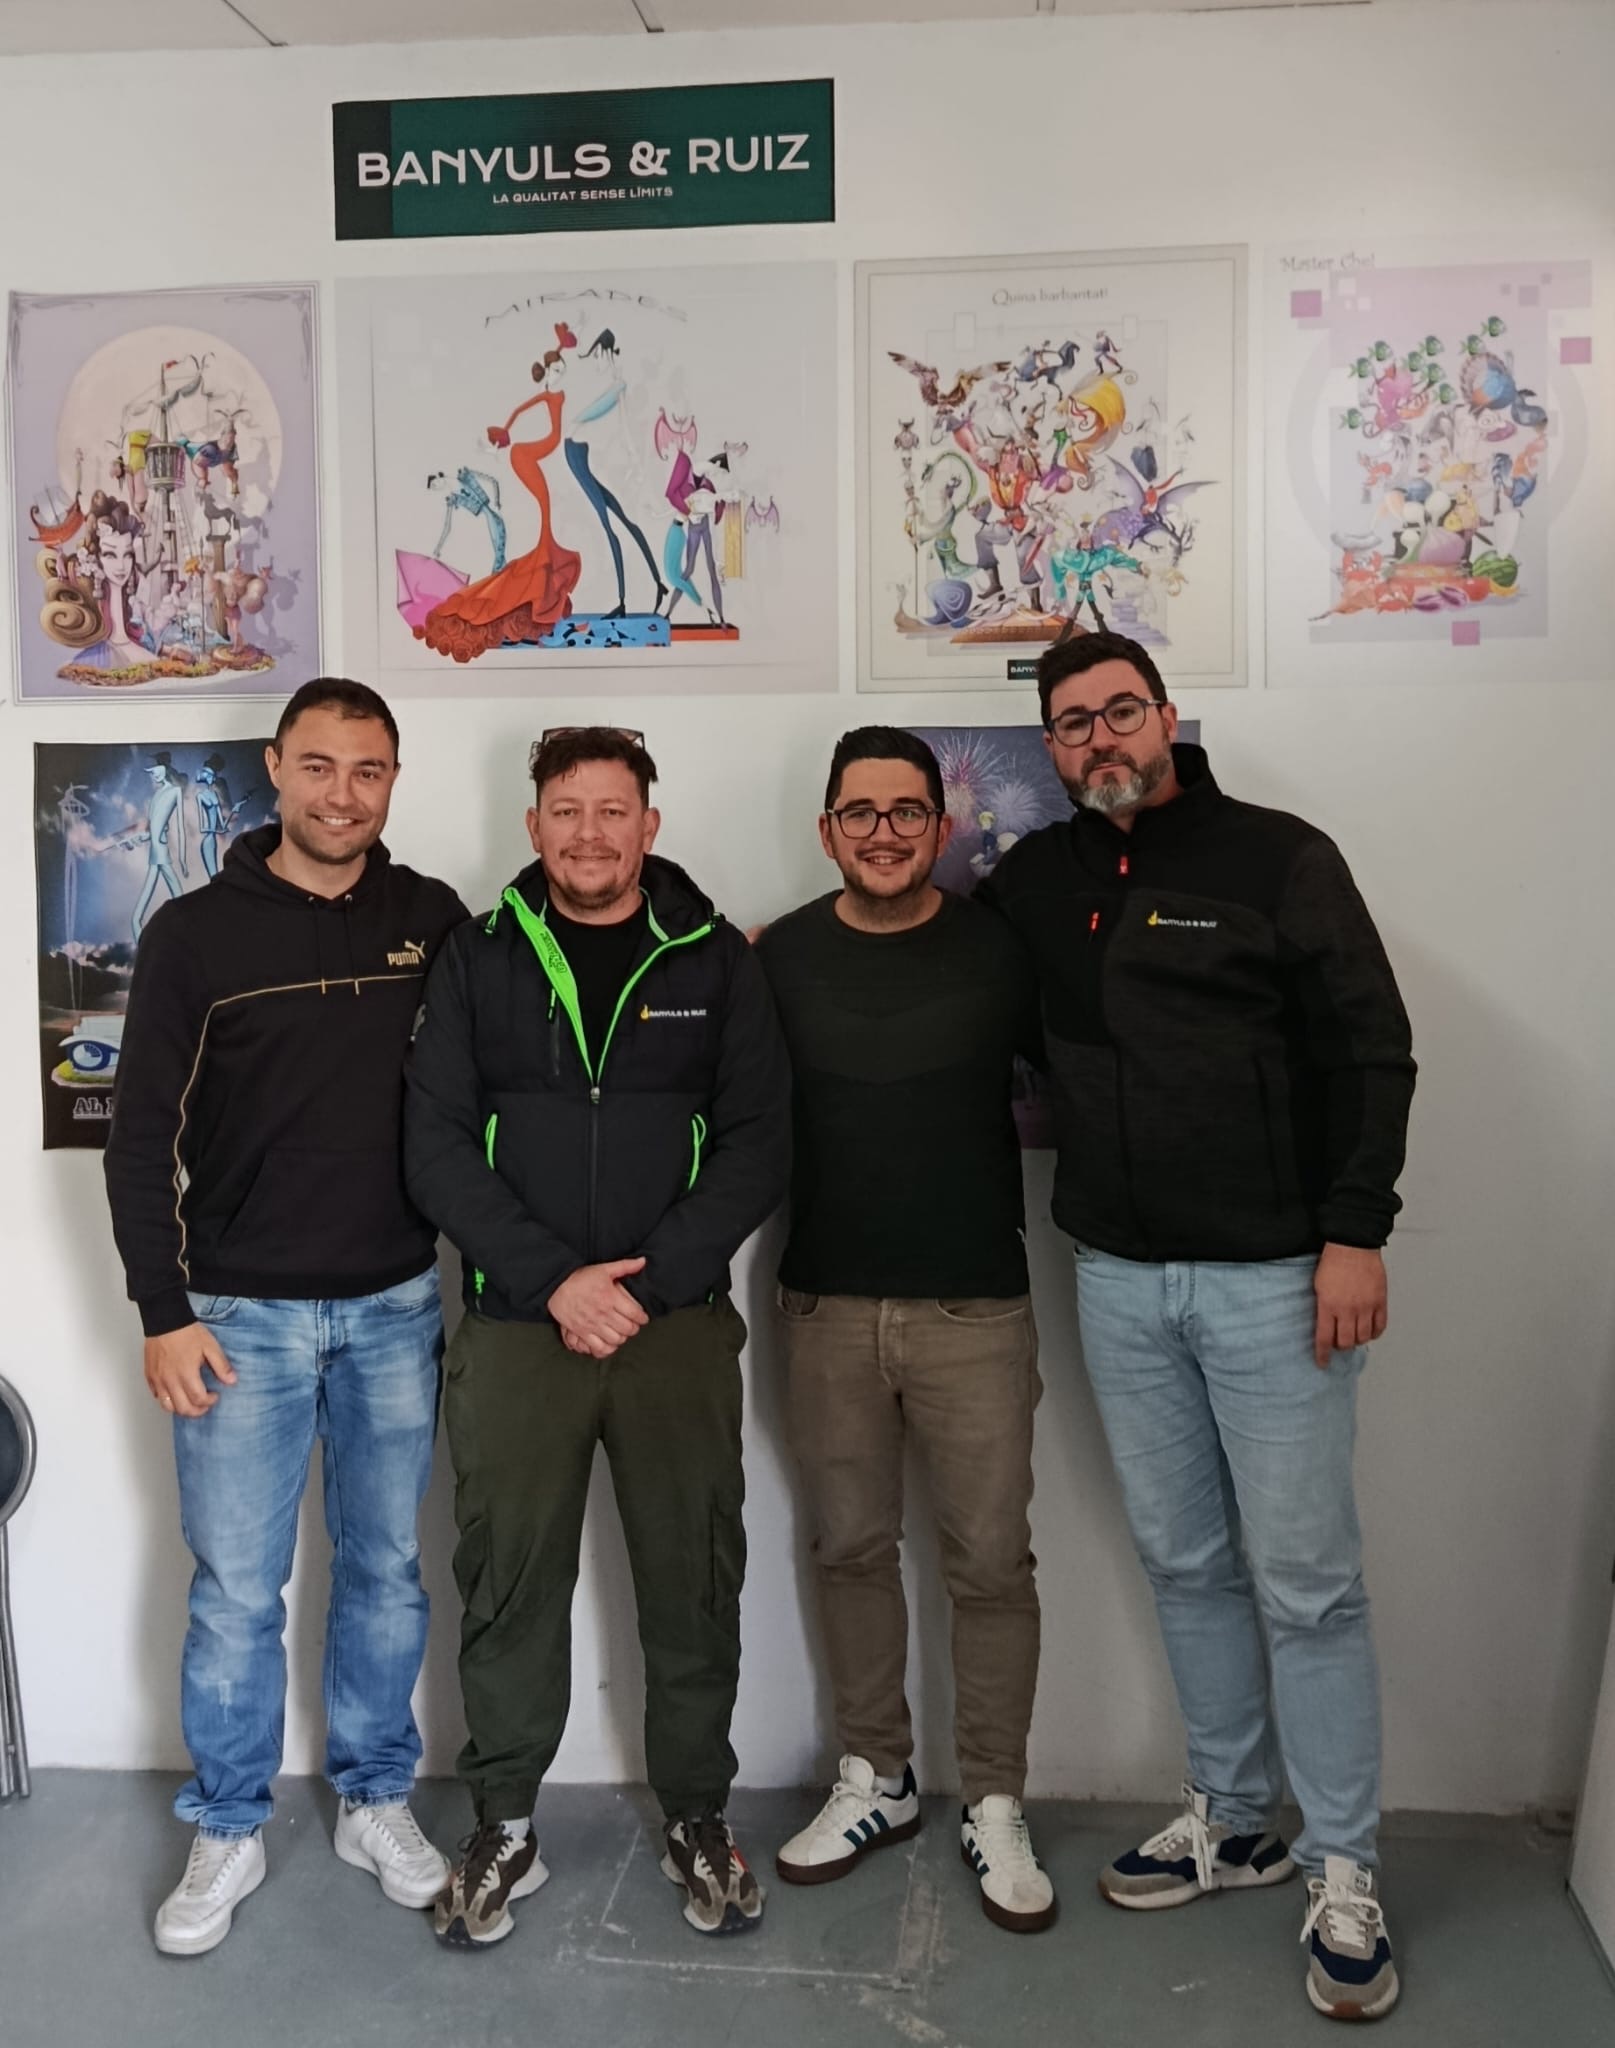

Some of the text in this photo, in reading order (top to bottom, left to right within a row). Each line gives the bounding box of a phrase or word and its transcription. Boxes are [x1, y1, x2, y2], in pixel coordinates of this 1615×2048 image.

[358, 133, 811, 188] BANYULS & RUIZ
[492, 194, 510, 205] LA
[512, 191, 577, 204] QUALITAT
[580, 188, 627, 201] SENSE
[992, 287, 1036, 305] Quina
[387, 951, 420, 966] PUMA
